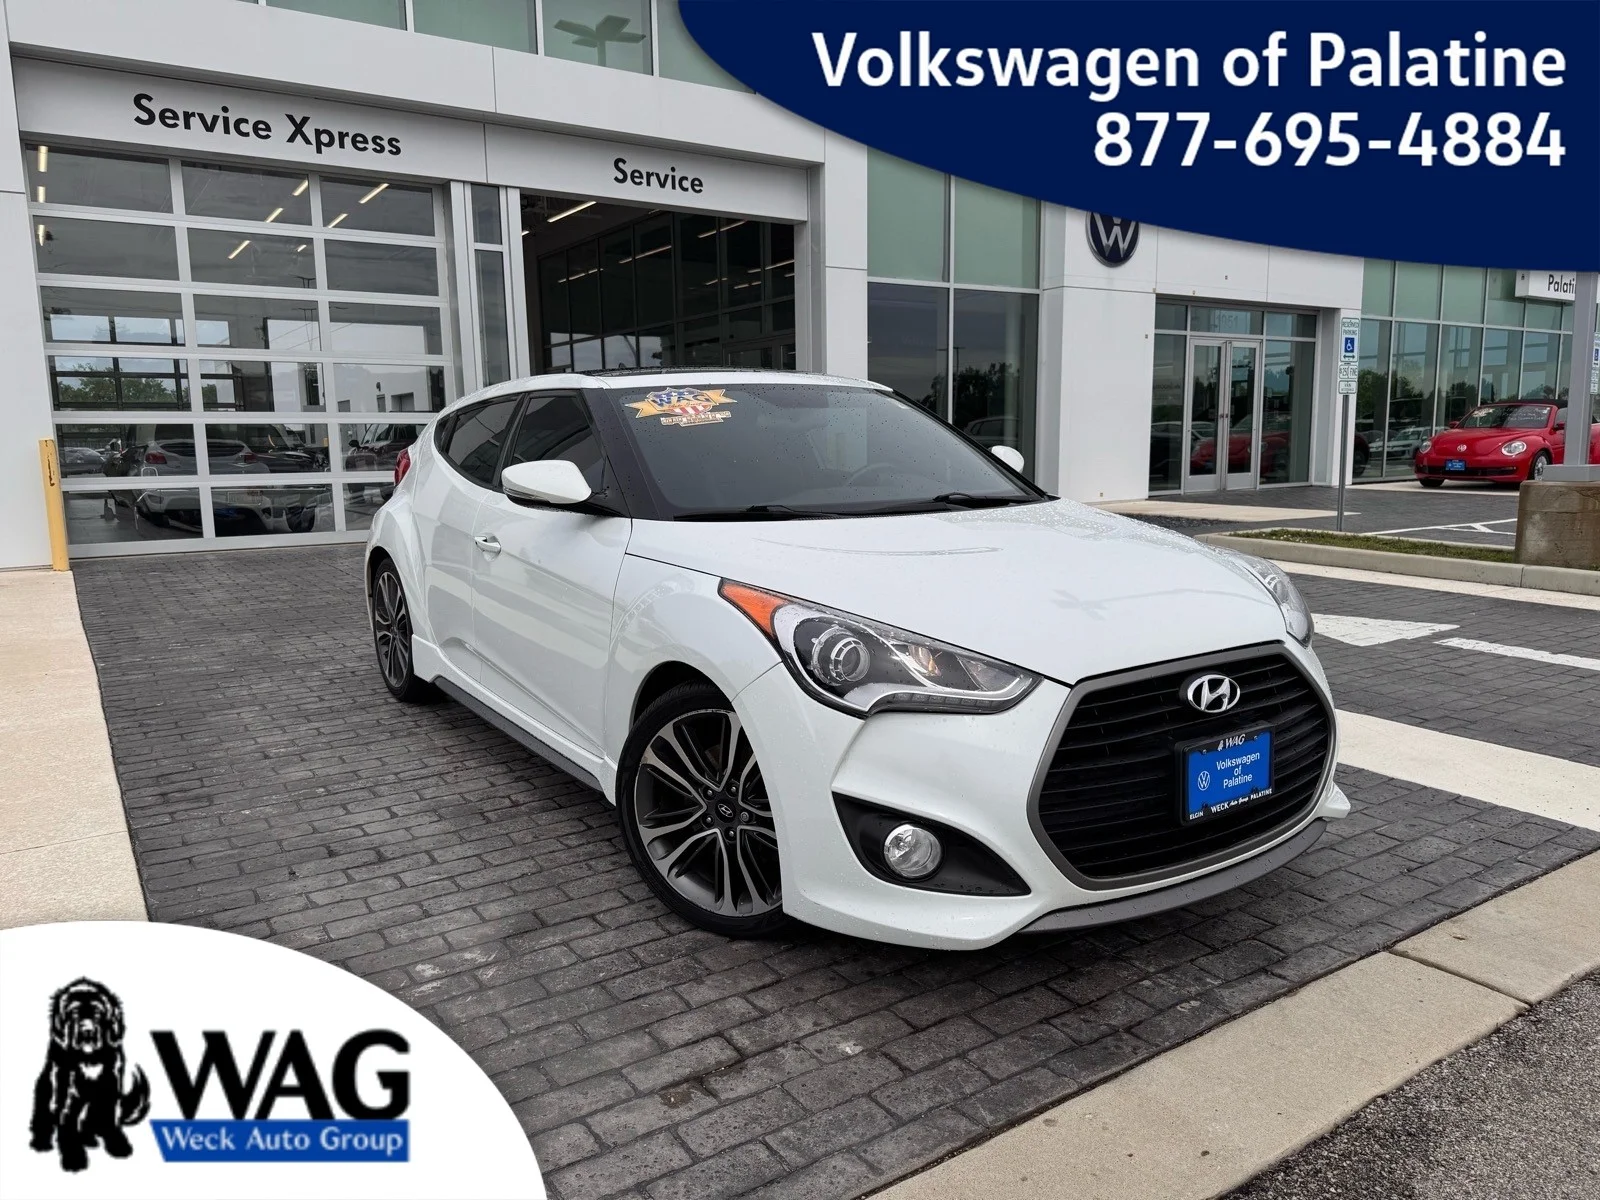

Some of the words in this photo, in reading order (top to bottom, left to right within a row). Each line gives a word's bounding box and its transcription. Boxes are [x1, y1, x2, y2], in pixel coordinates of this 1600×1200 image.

[133, 93, 272, 140] Service
[285, 113, 402, 156] Xpress
[613, 157, 704, 194] Service
[1548, 274, 1576, 294] Palati
[1225, 734, 1246, 749] WAG
[1216, 752, 1260, 771] Volkswagen
[1234, 765, 1242, 776] of
[1223, 774, 1253, 789] Palatine
[1189, 811, 1204, 820] ELGIN
[1210, 802, 1230, 813] WECK
[1250, 788, 1273, 800] PALATINE
